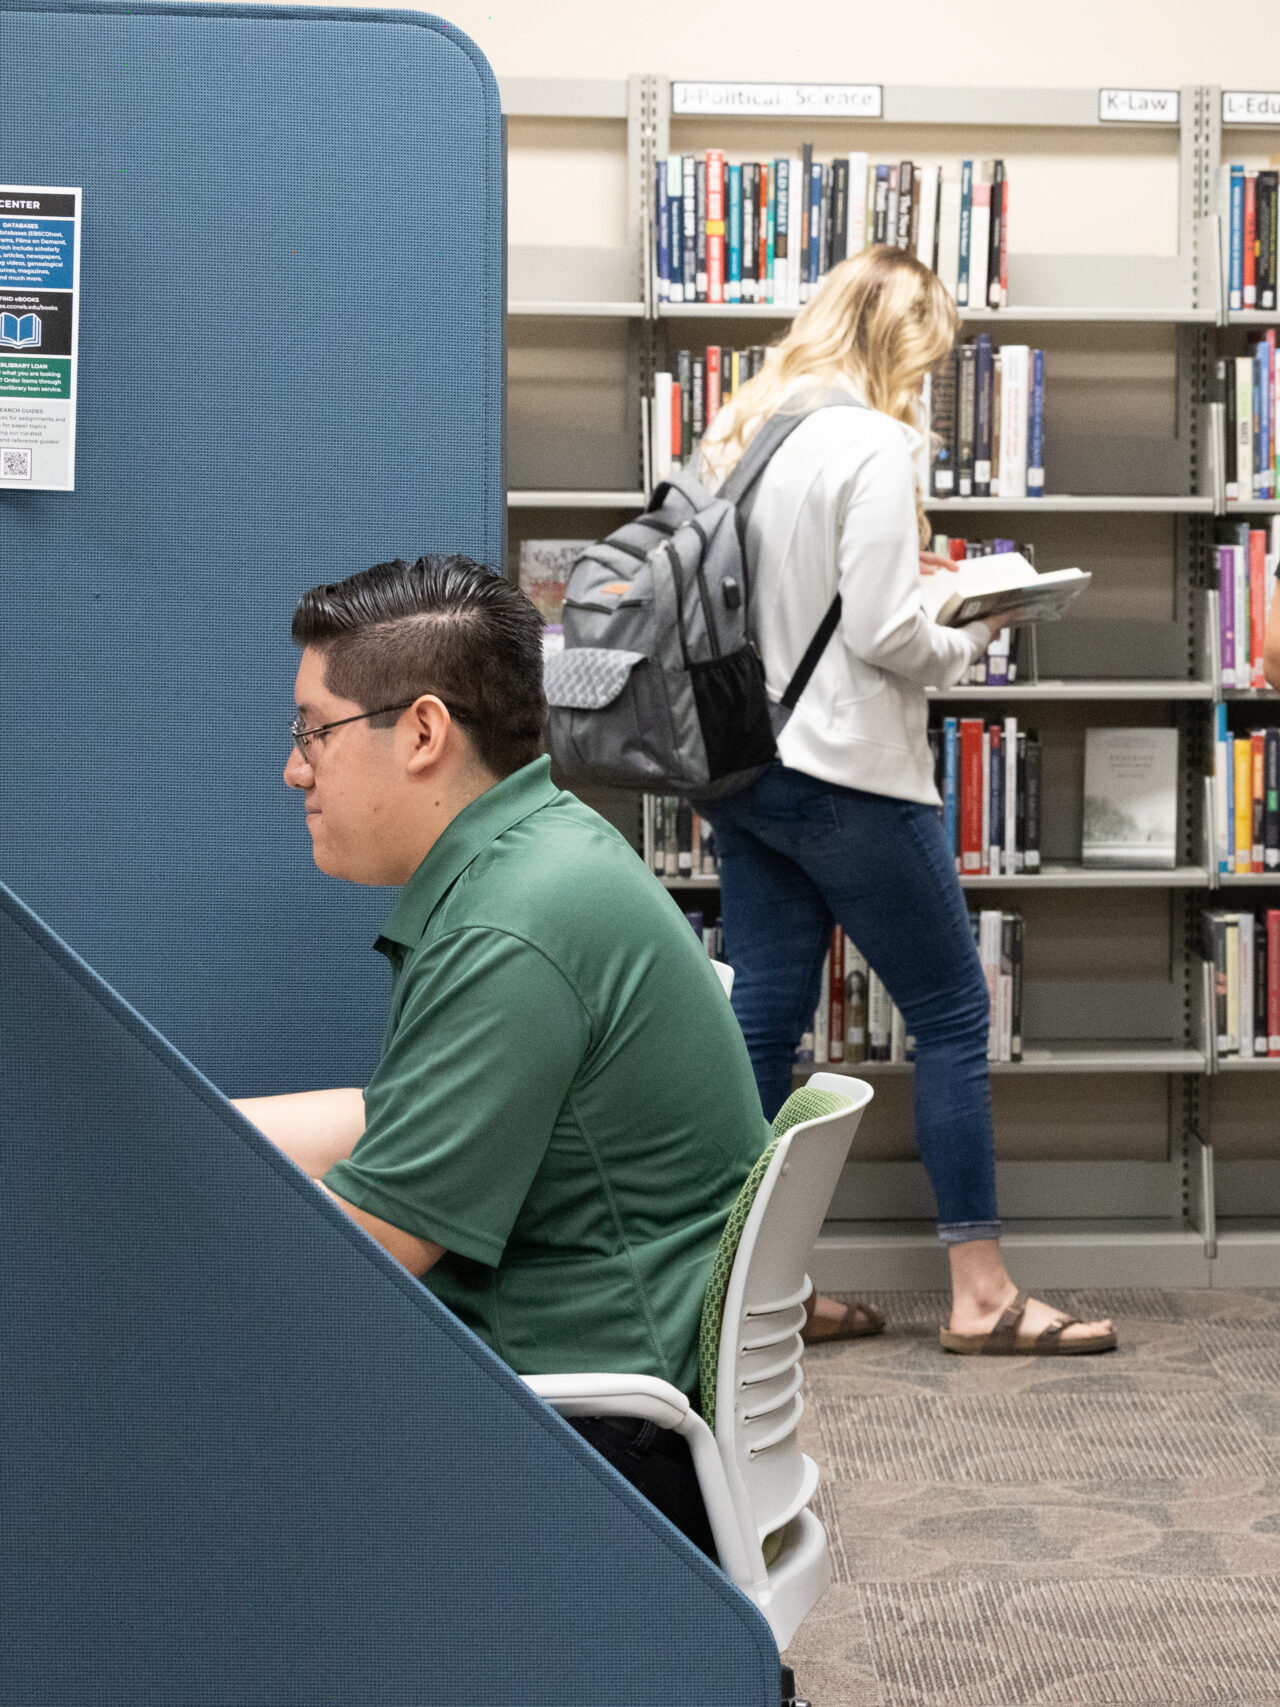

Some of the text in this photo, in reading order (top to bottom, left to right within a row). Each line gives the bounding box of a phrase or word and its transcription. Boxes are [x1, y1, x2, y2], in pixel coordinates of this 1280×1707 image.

[796, 89, 872, 106] Science
[1107, 94, 1168, 111] K-Law
[0, 200, 40, 210] CENTER
